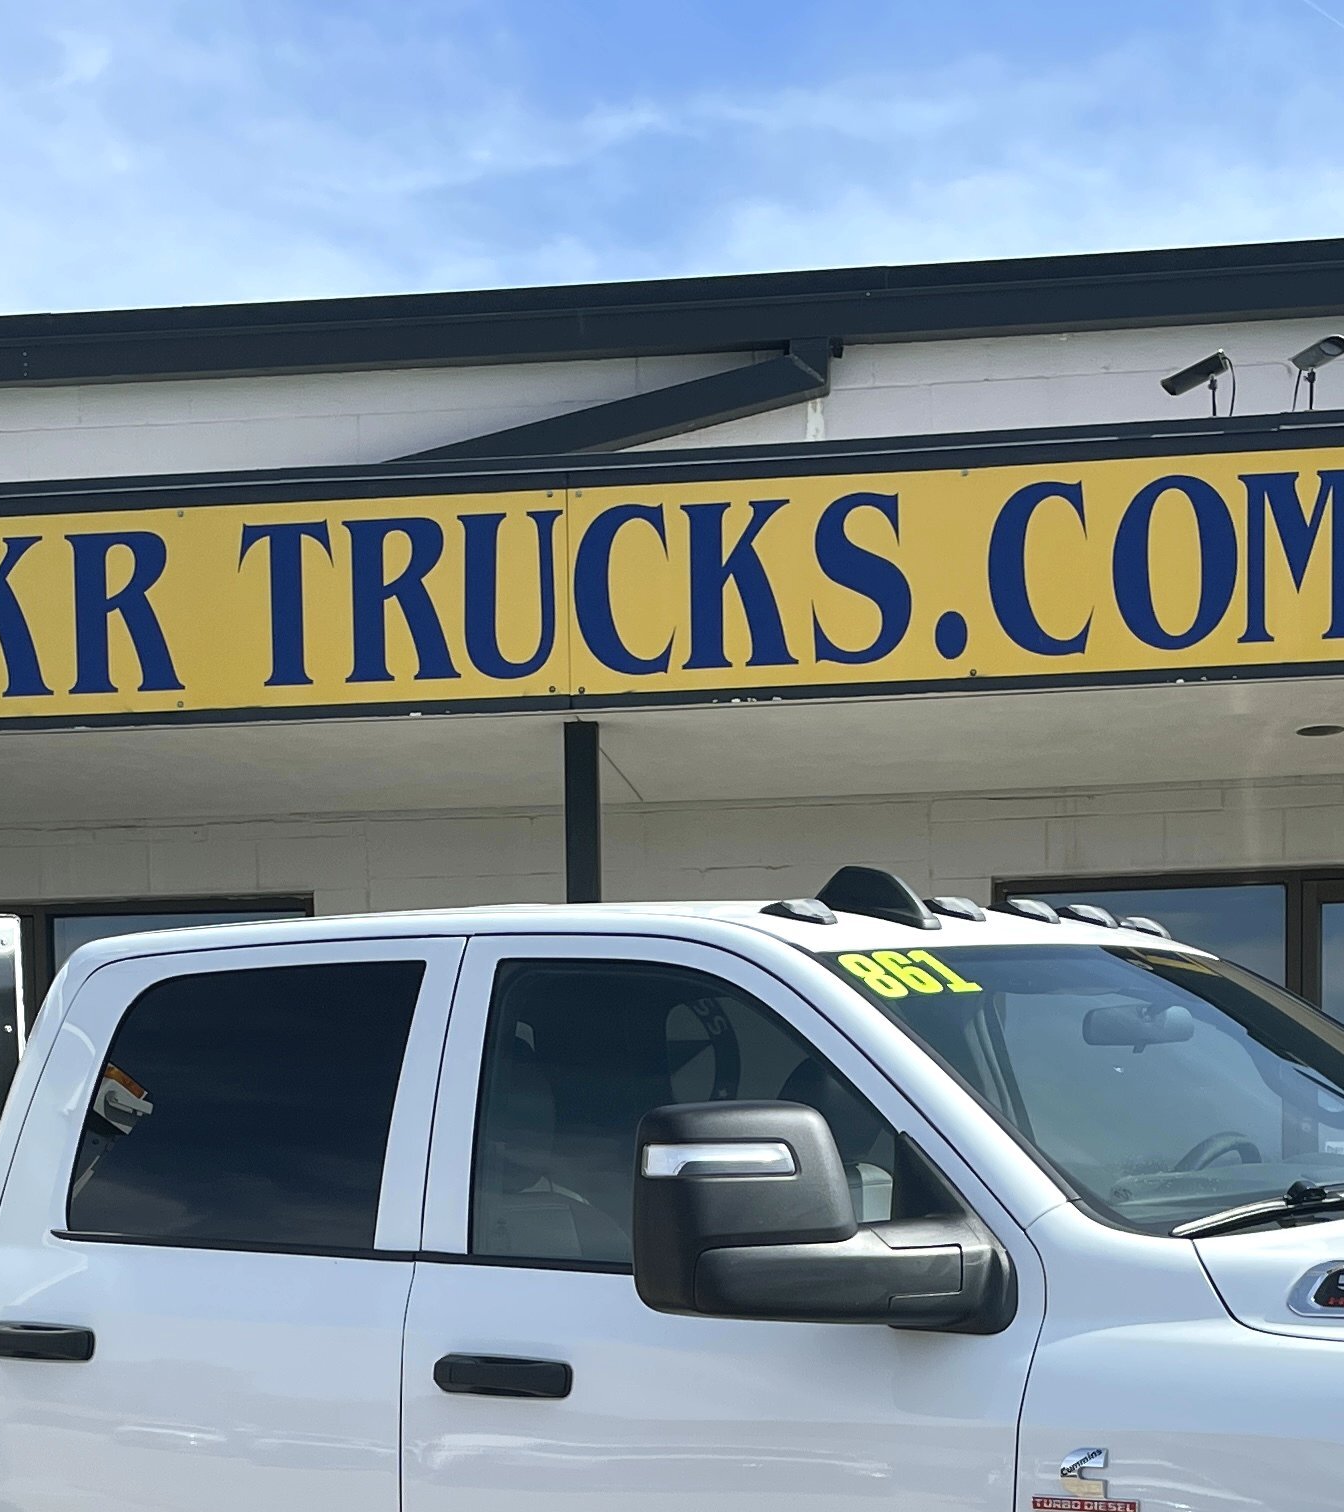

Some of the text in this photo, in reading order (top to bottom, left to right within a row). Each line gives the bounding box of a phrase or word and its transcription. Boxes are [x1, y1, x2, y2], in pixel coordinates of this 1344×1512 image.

[837, 949, 984, 999] 861
[1060, 1448, 1103, 1477] Cummins
[1034, 1498, 1136, 1512] TURBO DIESEL
